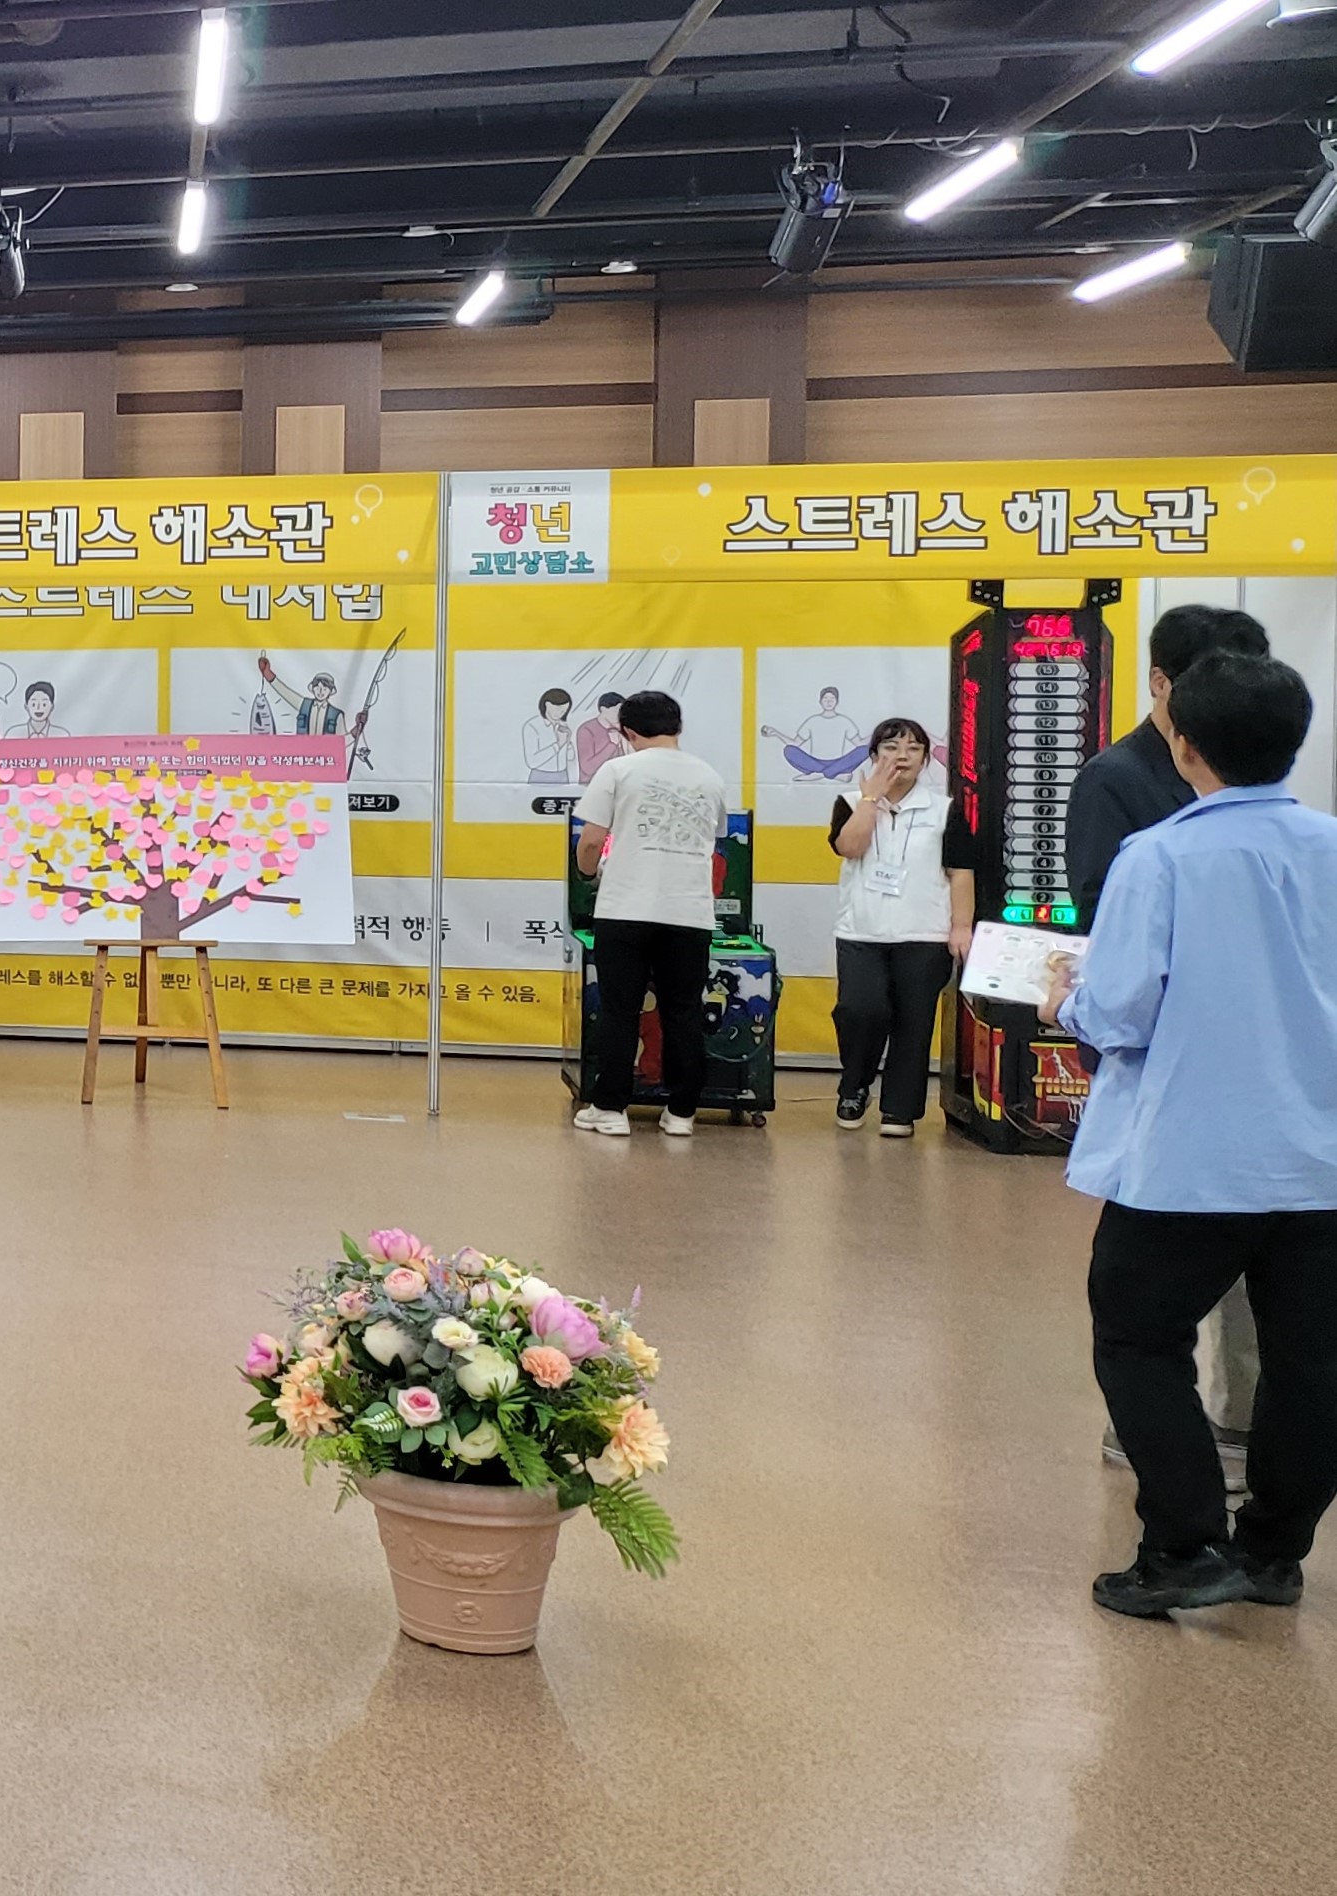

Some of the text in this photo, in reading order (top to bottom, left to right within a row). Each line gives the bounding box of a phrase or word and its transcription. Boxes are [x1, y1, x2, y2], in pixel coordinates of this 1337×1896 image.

[149, 502, 333, 564] 해소관
[486, 501, 571, 545] 청년
[723, 486, 1216, 557] 스트레스 해소관
[469, 551, 595, 575] 고민상담소
[104, 971, 117, 988] 수
[160, 972, 191, 990] 뿐만
[257, 976, 273, 992] 또
[280, 978, 312, 994] 다른
[318, 979, 335, 995] 큰
[342, 979, 391, 998] 문제를
[454, 983, 471, 1001] 올
[478, 984, 495, 1001] 수
